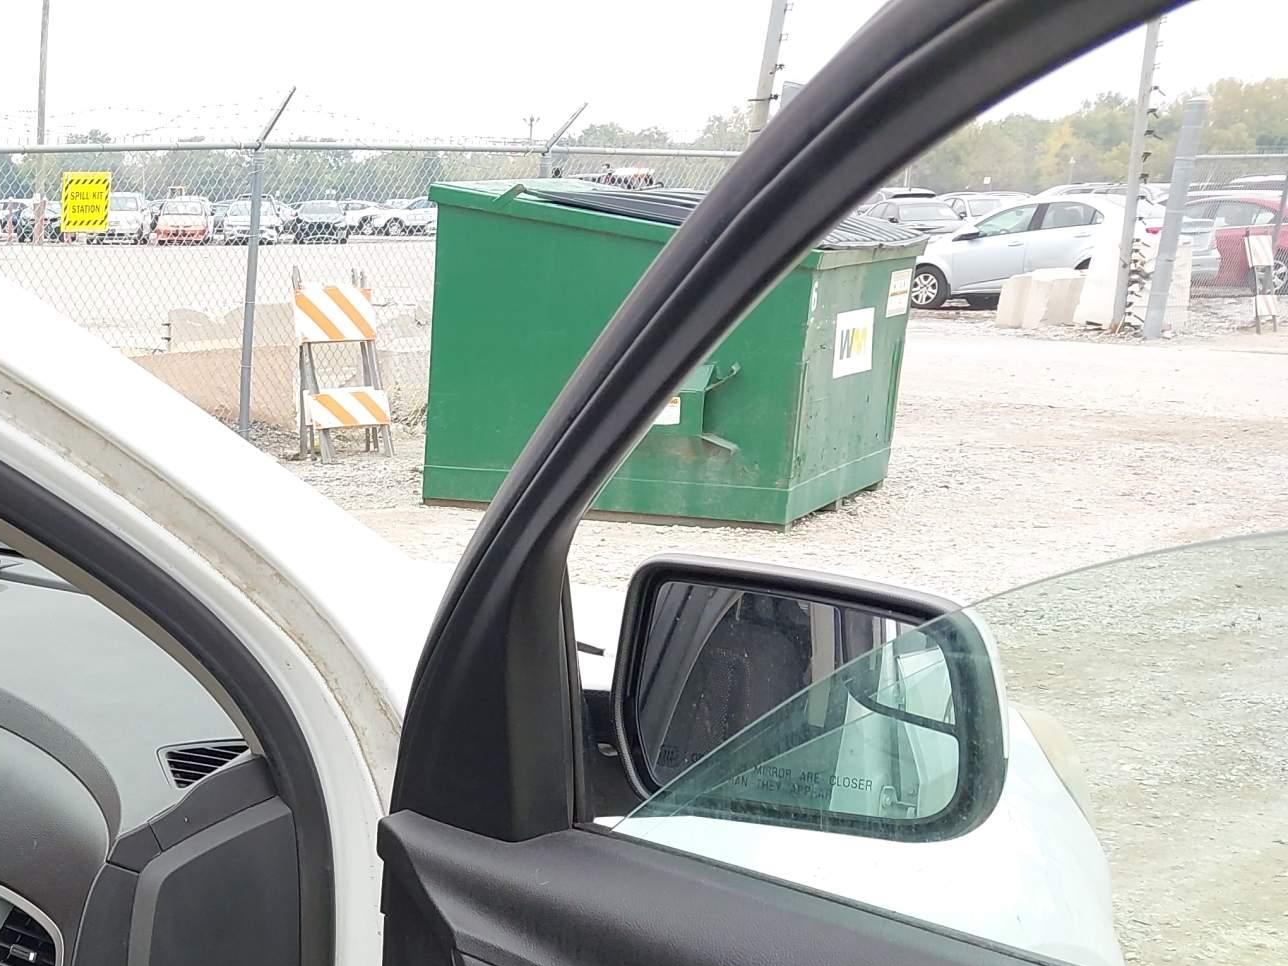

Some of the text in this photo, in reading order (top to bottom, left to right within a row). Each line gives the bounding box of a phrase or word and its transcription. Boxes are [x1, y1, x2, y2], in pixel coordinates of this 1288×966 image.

[70, 191, 103, 200] SPILL KIT
[71, 204, 100, 214] STATION
[800, 771, 820, 784] ARE
[829, 775, 872, 791] CLOSER
